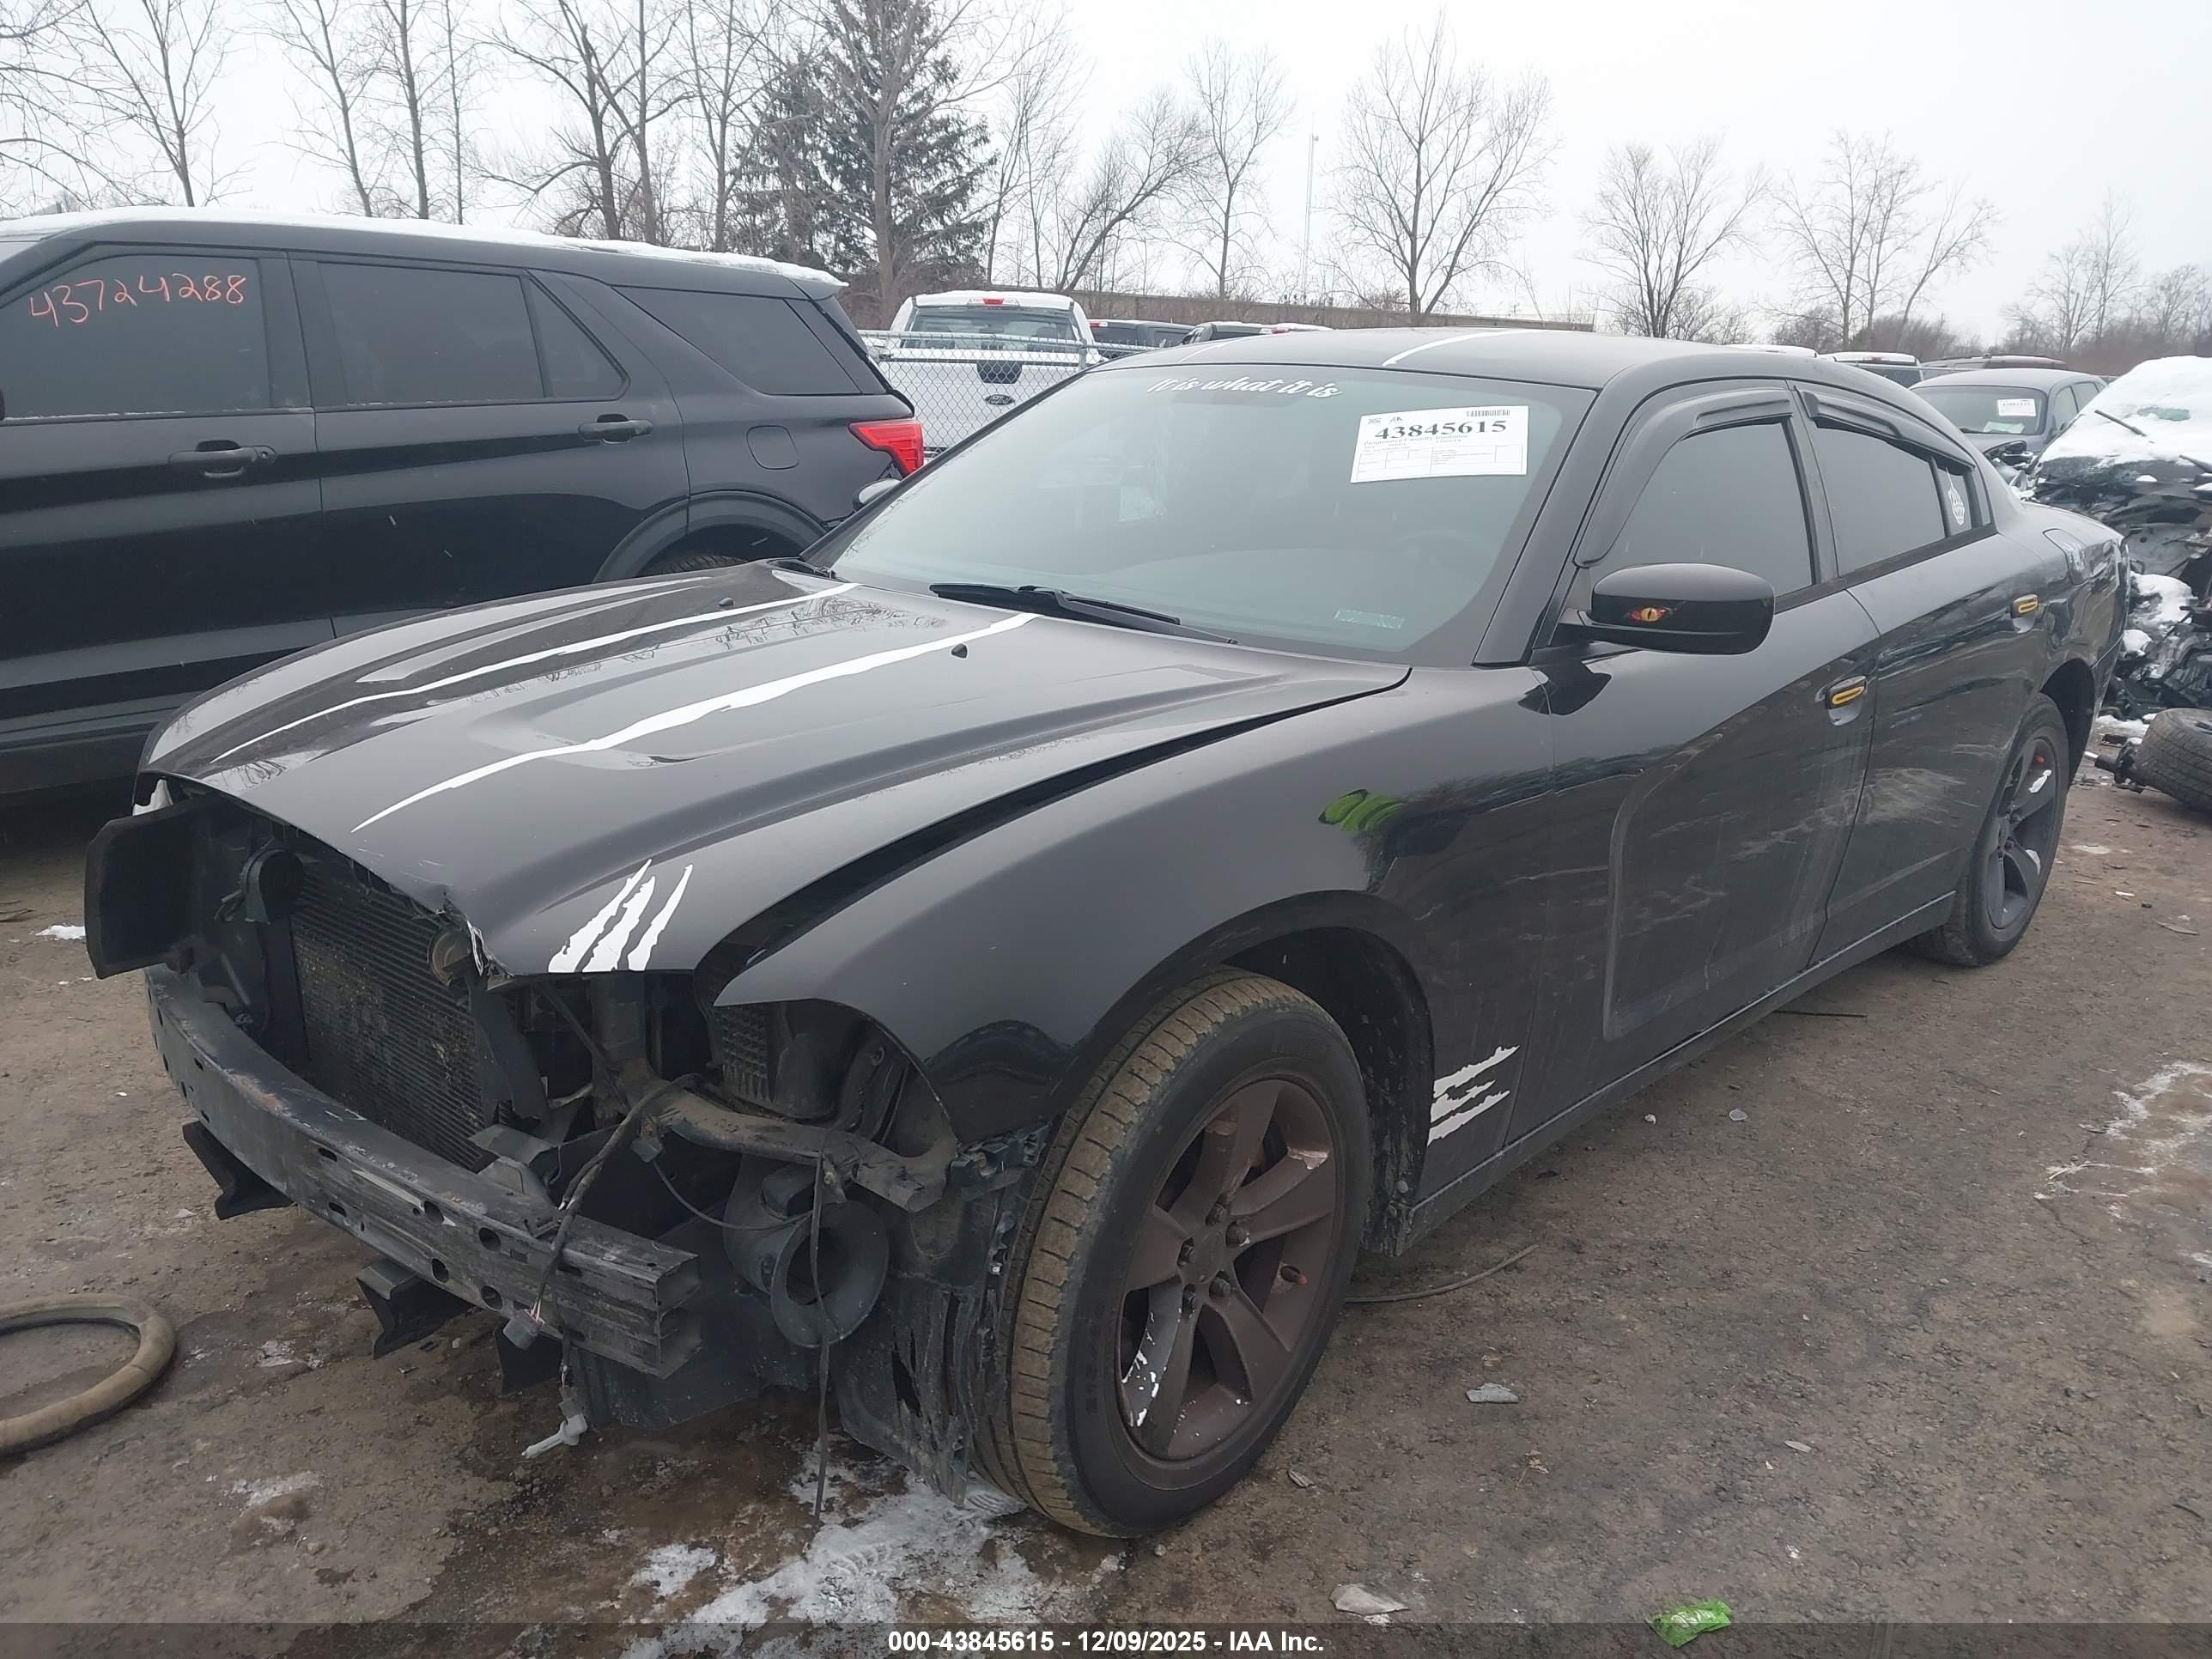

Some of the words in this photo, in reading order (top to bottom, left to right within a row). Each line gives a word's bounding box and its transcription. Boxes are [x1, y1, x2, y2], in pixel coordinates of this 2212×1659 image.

[29, 272, 247, 327] 43724288
[1147, 378, 1179, 392] It
[1171, 377, 1202, 392] is
[1201, 376, 1285, 392] what
[1277, 380, 1313, 394] it
[1305, 383, 1342, 398] is
[1375, 420, 1507, 440] 43845615
